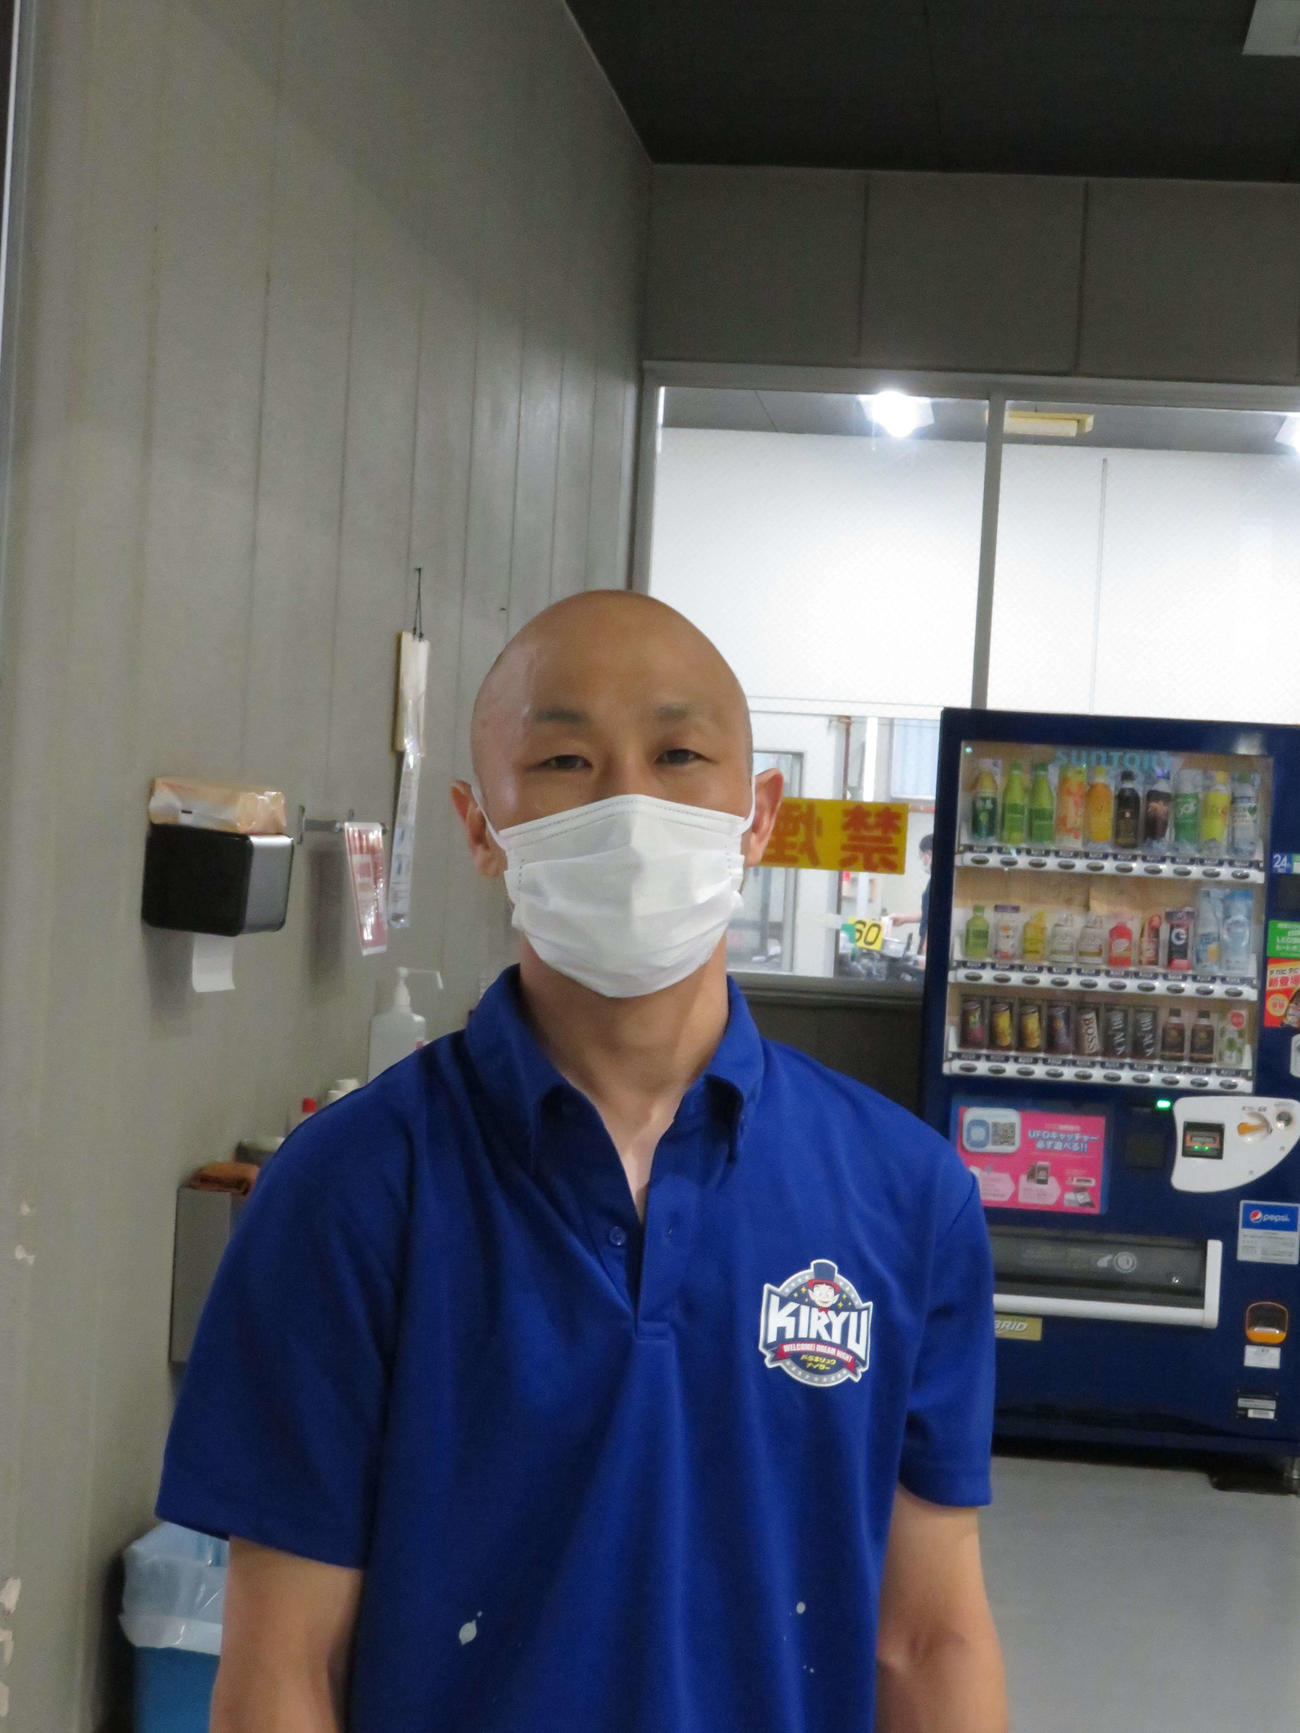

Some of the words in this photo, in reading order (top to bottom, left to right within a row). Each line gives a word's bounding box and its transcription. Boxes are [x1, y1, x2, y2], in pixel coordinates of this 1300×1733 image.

[1273, 854, 1288, 869] 24
[1083, 1014, 1098, 1055] BOSS
[1263, 1212, 1289, 1223] pepsi
[767, 1294, 868, 1361] KIRYU
